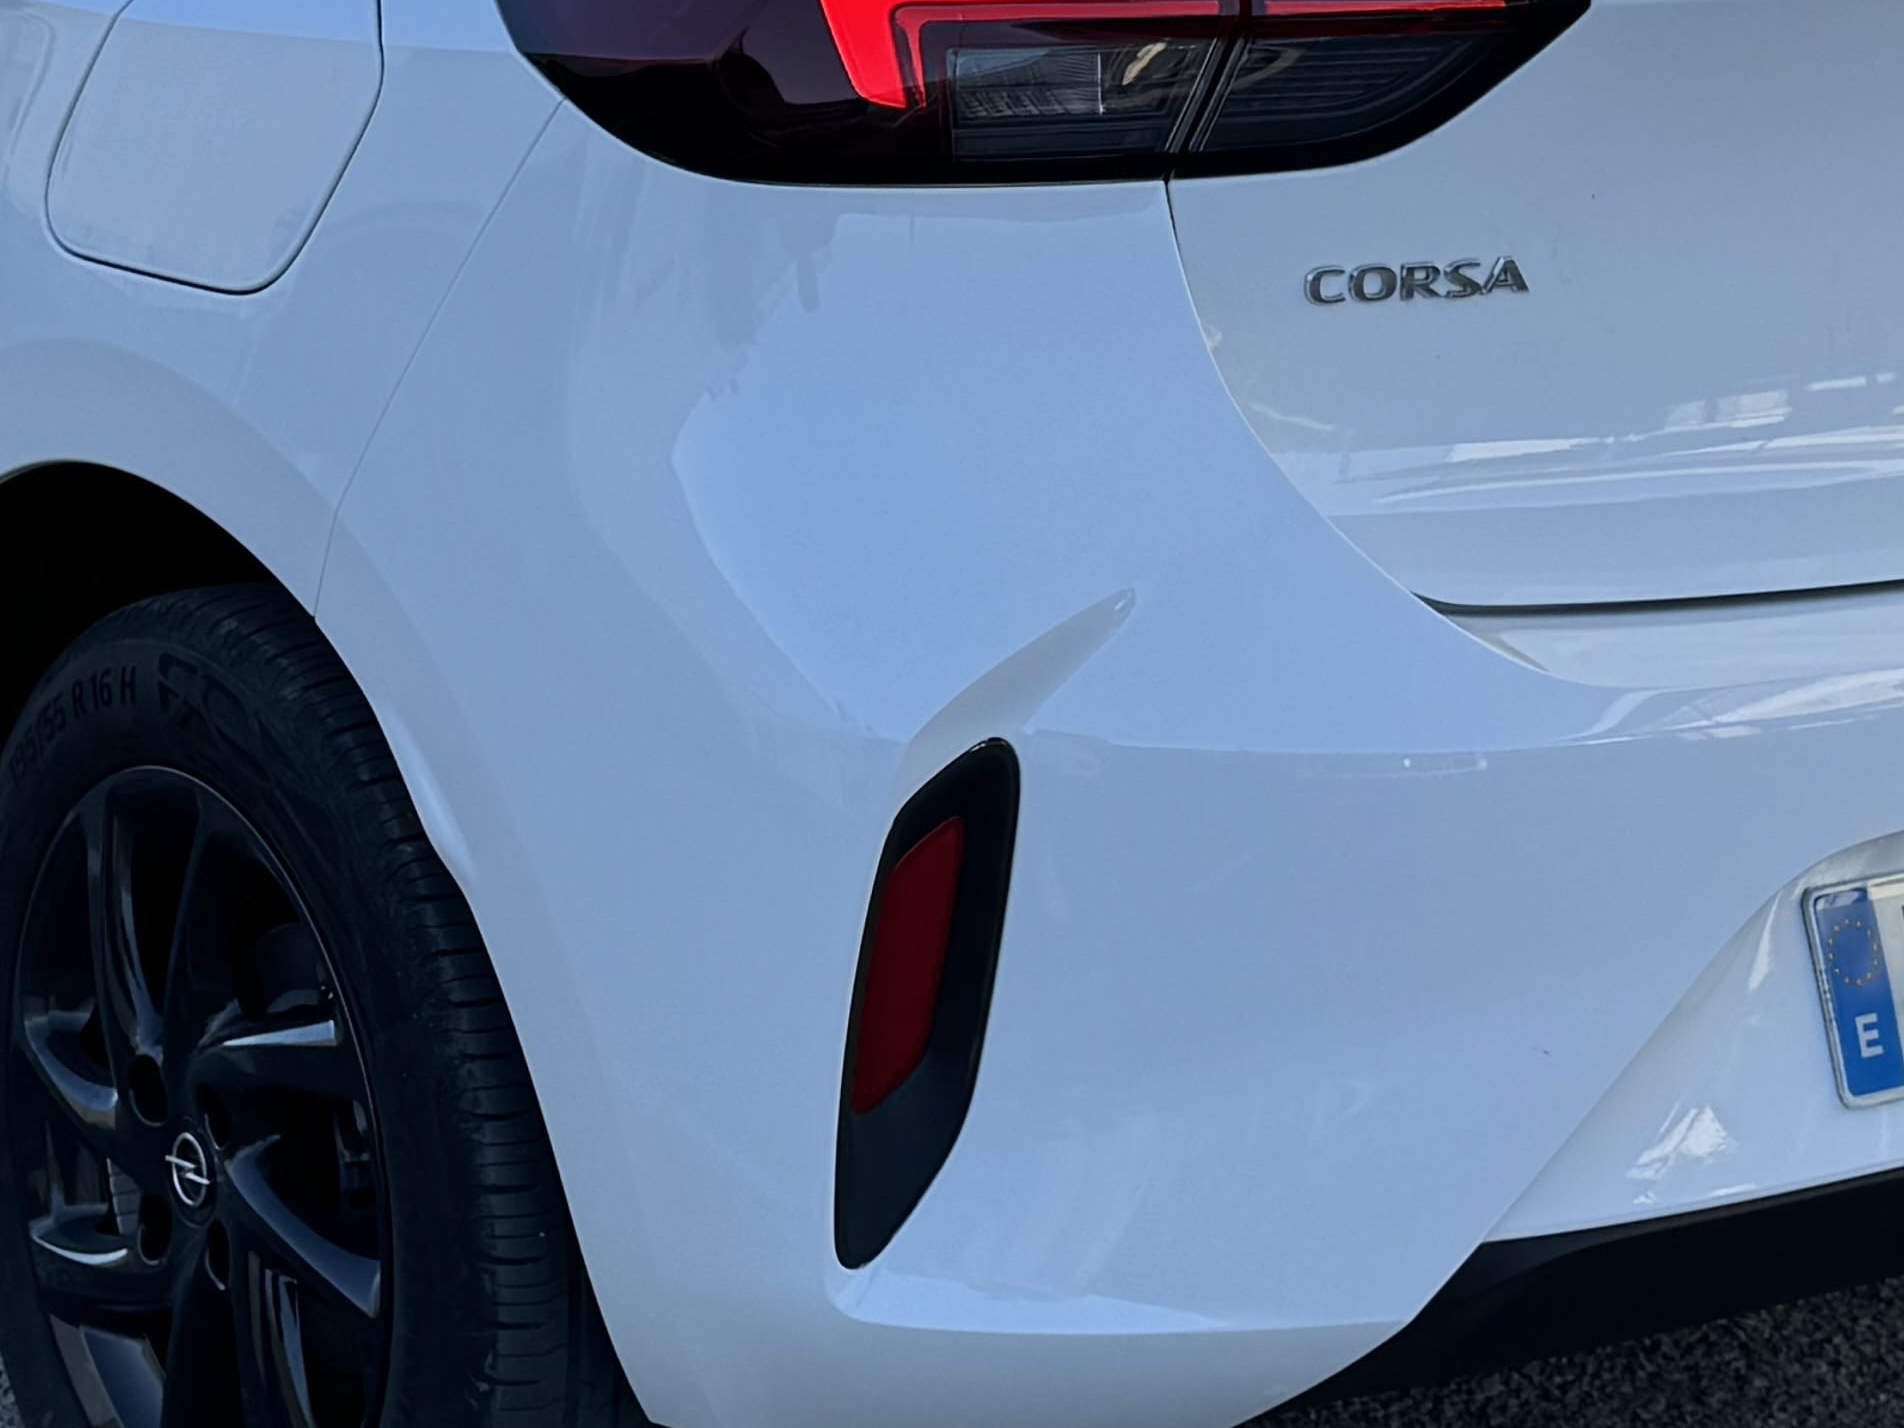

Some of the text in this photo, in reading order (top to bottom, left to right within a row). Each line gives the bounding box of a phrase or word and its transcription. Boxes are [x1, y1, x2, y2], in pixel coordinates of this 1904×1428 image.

[1305, 256, 1530, 305] CORSA
[120, 665, 137, 706] H
[1857, 1013, 1883, 1058] E
